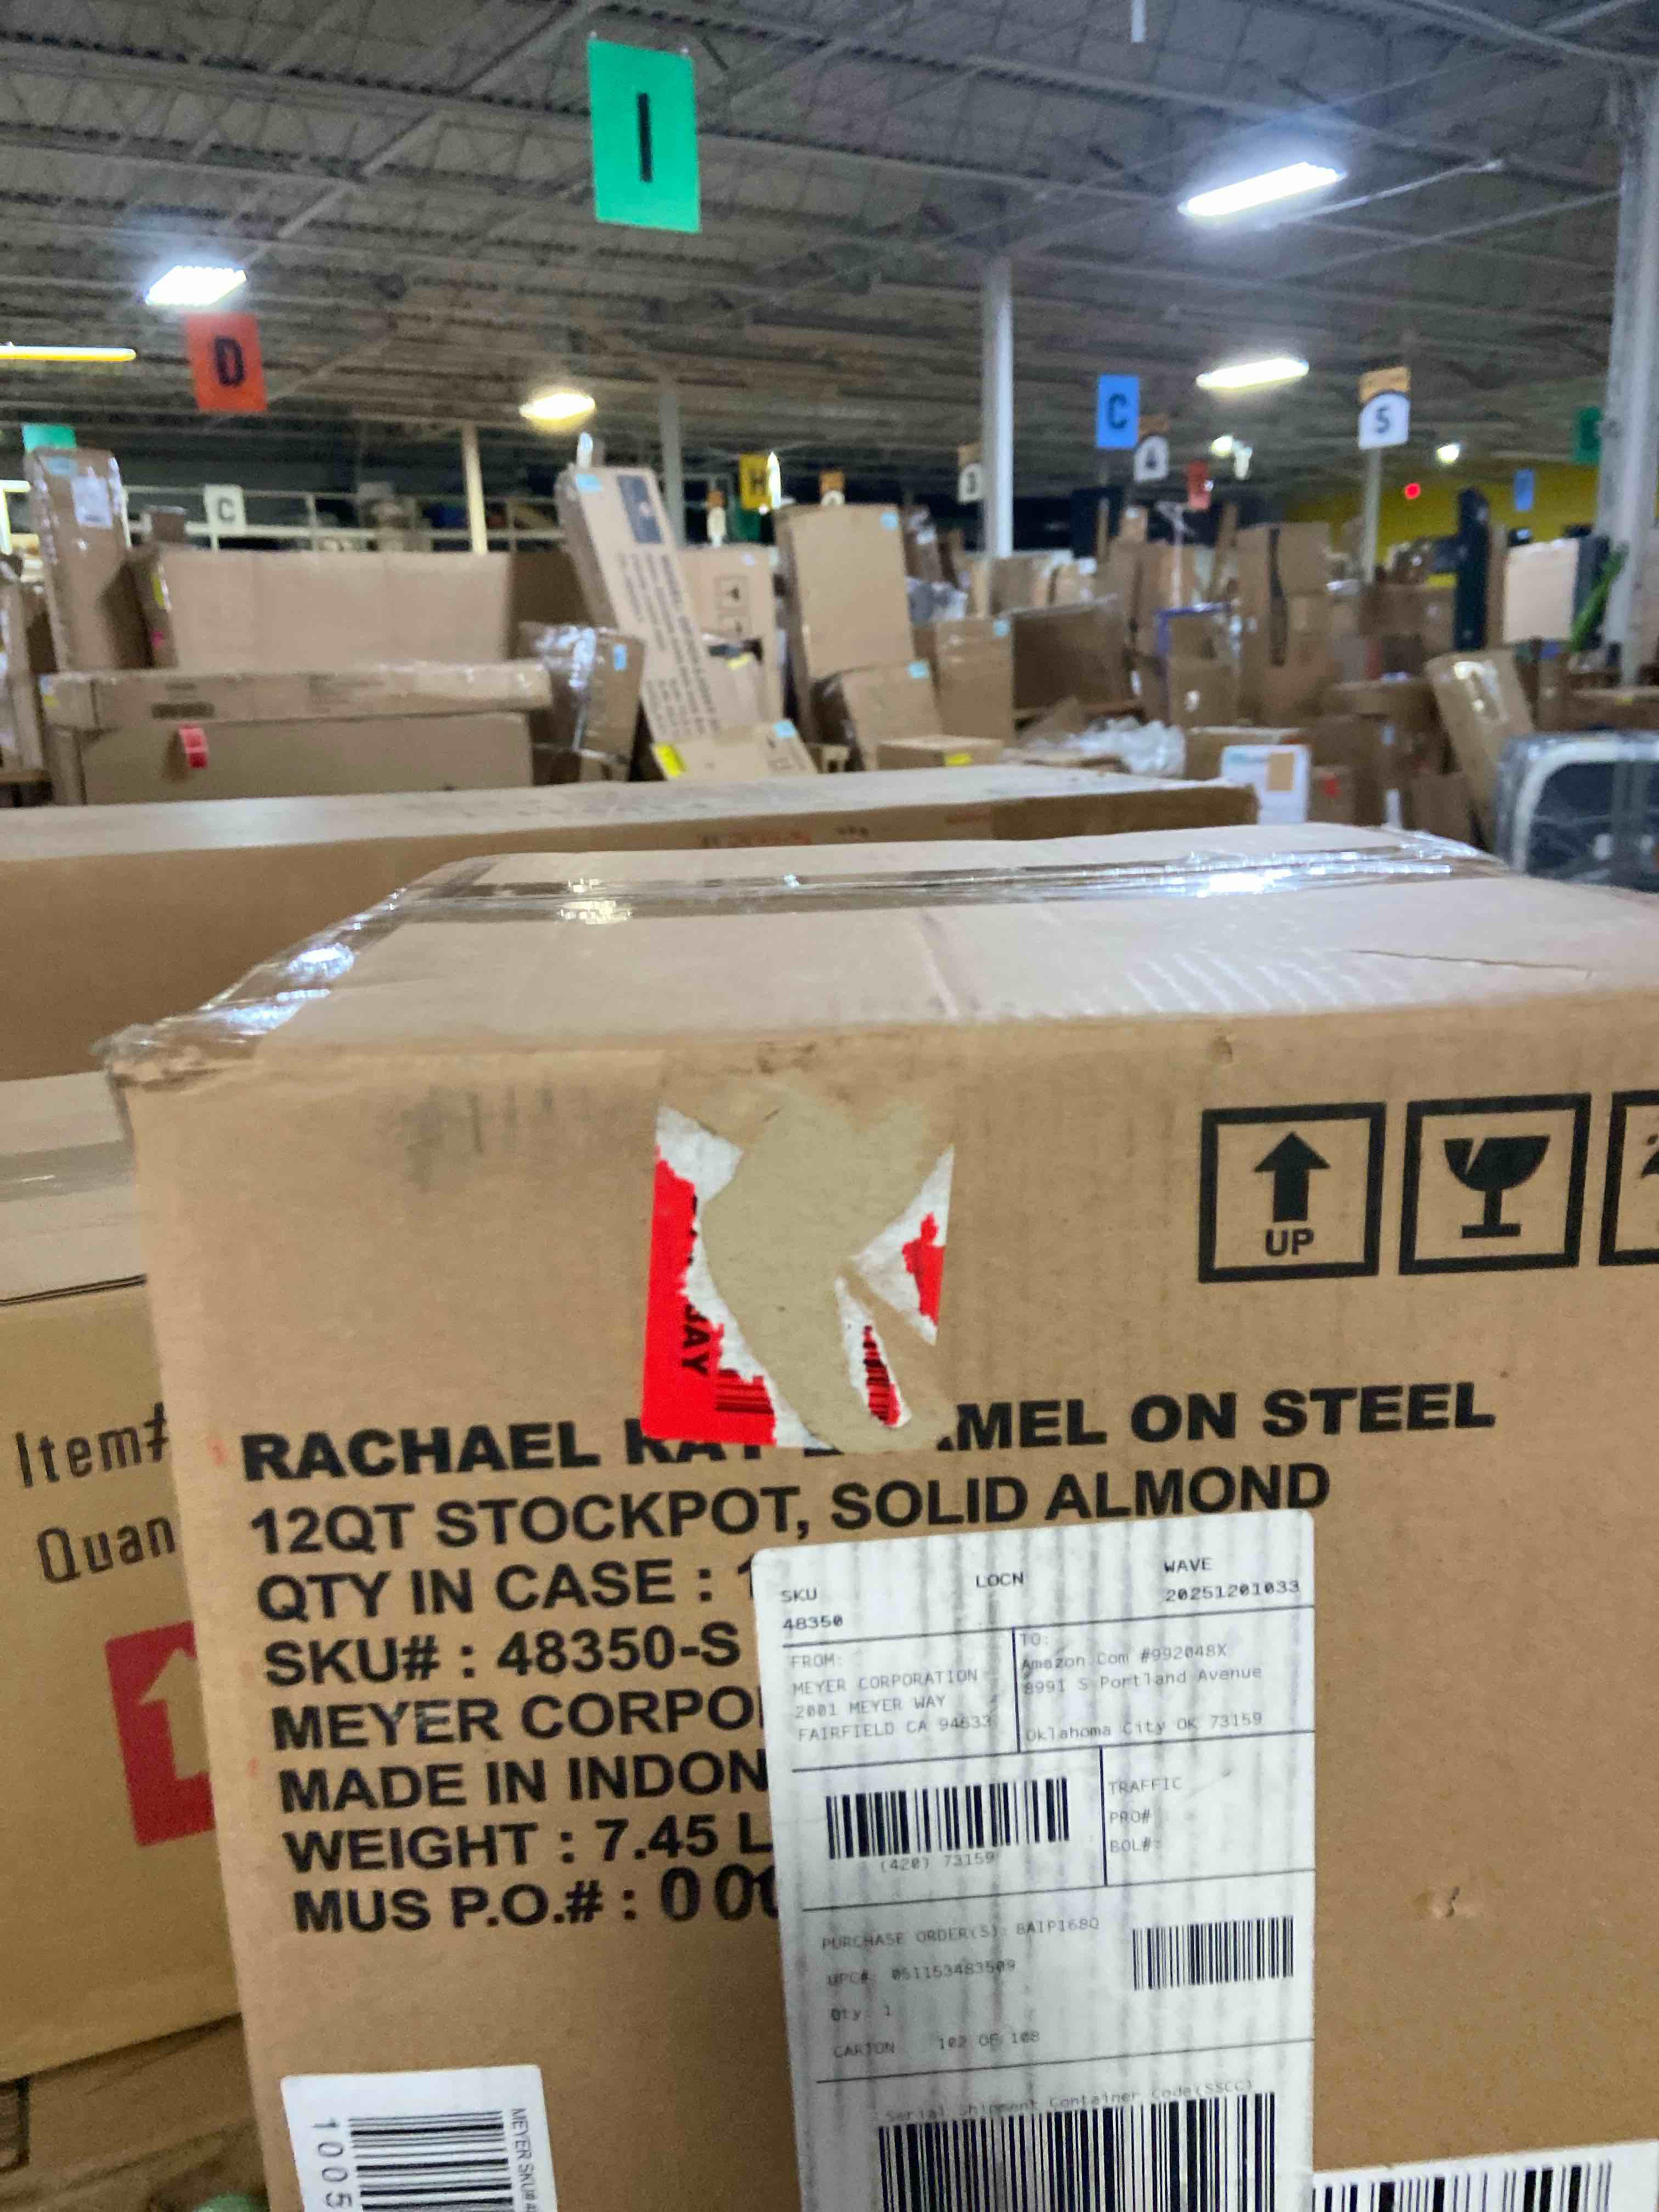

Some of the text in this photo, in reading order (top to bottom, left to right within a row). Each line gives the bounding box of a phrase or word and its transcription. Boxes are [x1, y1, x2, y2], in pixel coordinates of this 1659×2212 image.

[636, 92, 653, 183] I
[213, 336, 246, 387] D
[1108, 393, 1128, 430] C
[218, 498, 236, 522] C
[1265, 1228, 1314, 1256] UP
[241, 1420, 601, 1481] RACHAEL
[1131, 1392, 1237, 1442] ON
[1262, 1382, 1496, 1437] STEEL
[251, 1462, 1330, 1554] 12QT STOCKPOT, SOLID ALMOND
[36, 1516, 176, 1584] Quan
[257, 1570, 391, 1622] QTY
[411, 1568, 474, 1615] IN
[496, 1558, 676, 1611] CASE
[781, 1557, 1213, 1603] SKU LOCN WAVE
[782, 1579, 1300, 1631] 48350 20251201033
[264, 1634, 441, 1686] SKU#
[497, 1621, 741, 1676] 48350-S
[1022, 1656, 1085, 1671] Amazon
[793, 1668, 978, 1696] MEYER CORPORATION
[1079, 1677, 1088, 1691] S
[1100, 1671, 1187, 1690] Portland
[1198, 1666, 1262, 1681] Avenue
[272, 1685, 764, 1751] MEYER CORPO
[795, 1694, 946, 1719] 2001 MEYER WAY
[1025, 1711, 1263, 1742] Oklahoma City OK 73159
[798, 1722, 894, 1742] FAIRFIELD
[906, 1718, 928, 1734] CA
[278, 1762, 467, 1813] MADE
[486, 1758, 547, 1805] IN
[1108, 1776, 1183, 1795] TRAFFIC
[281, 1822, 539, 1874] WEIGHT
[595, 1813, 719, 1862] 7.45
[294, 1888, 431, 1933] MUS
[822, 1932, 905, 1950] PURCHASE
[833, 2041, 896, 2059] CARTON
[511, 2107, 532, 2159] MEYER
